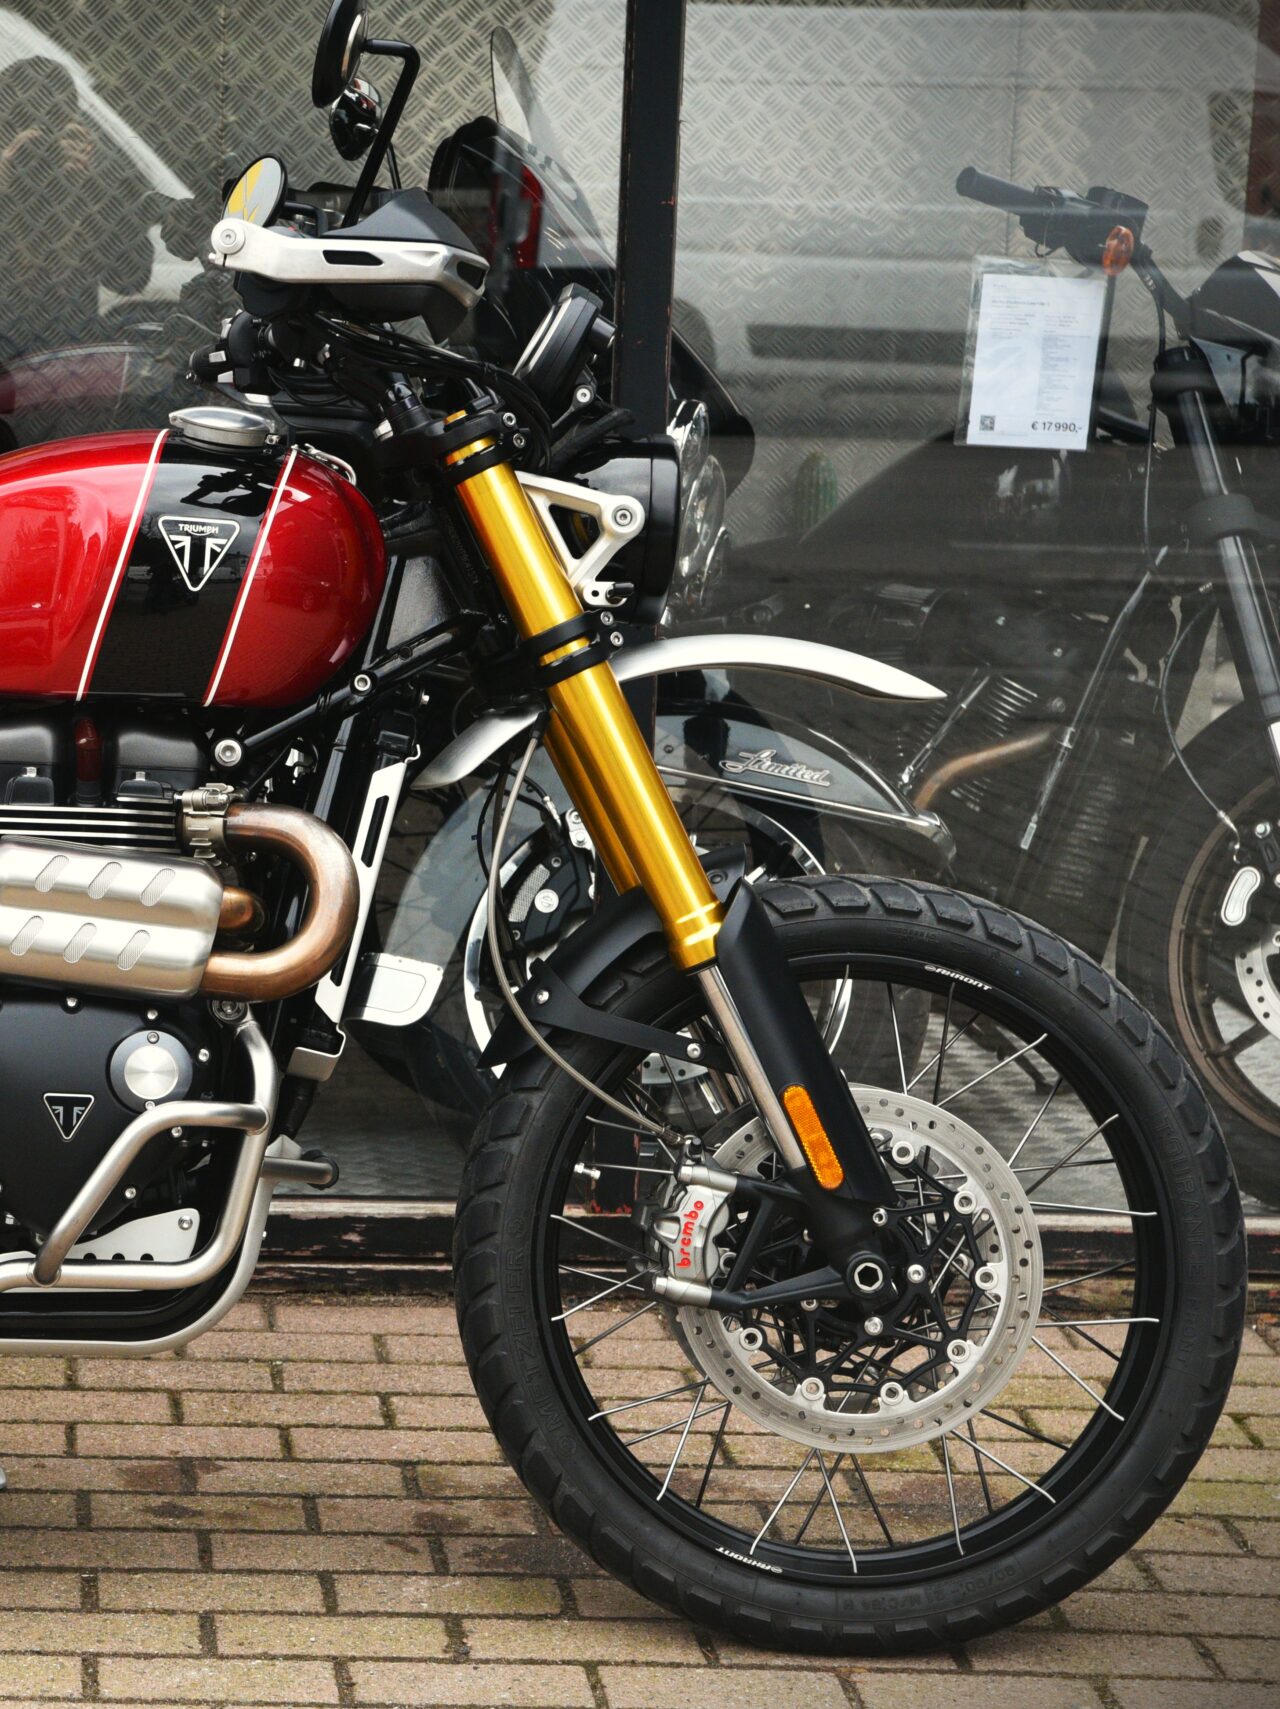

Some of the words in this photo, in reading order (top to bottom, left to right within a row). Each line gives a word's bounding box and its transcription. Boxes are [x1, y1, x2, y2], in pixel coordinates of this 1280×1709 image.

[178, 523, 220, 536] TRIUMPH
[718, 748, 831, 788] Limited
[1151, 1113, 1209, 1283] TOURANCE
[675, 1200, 705, 1268] brembo
[503, 1245, 564, 1434] METZELER
